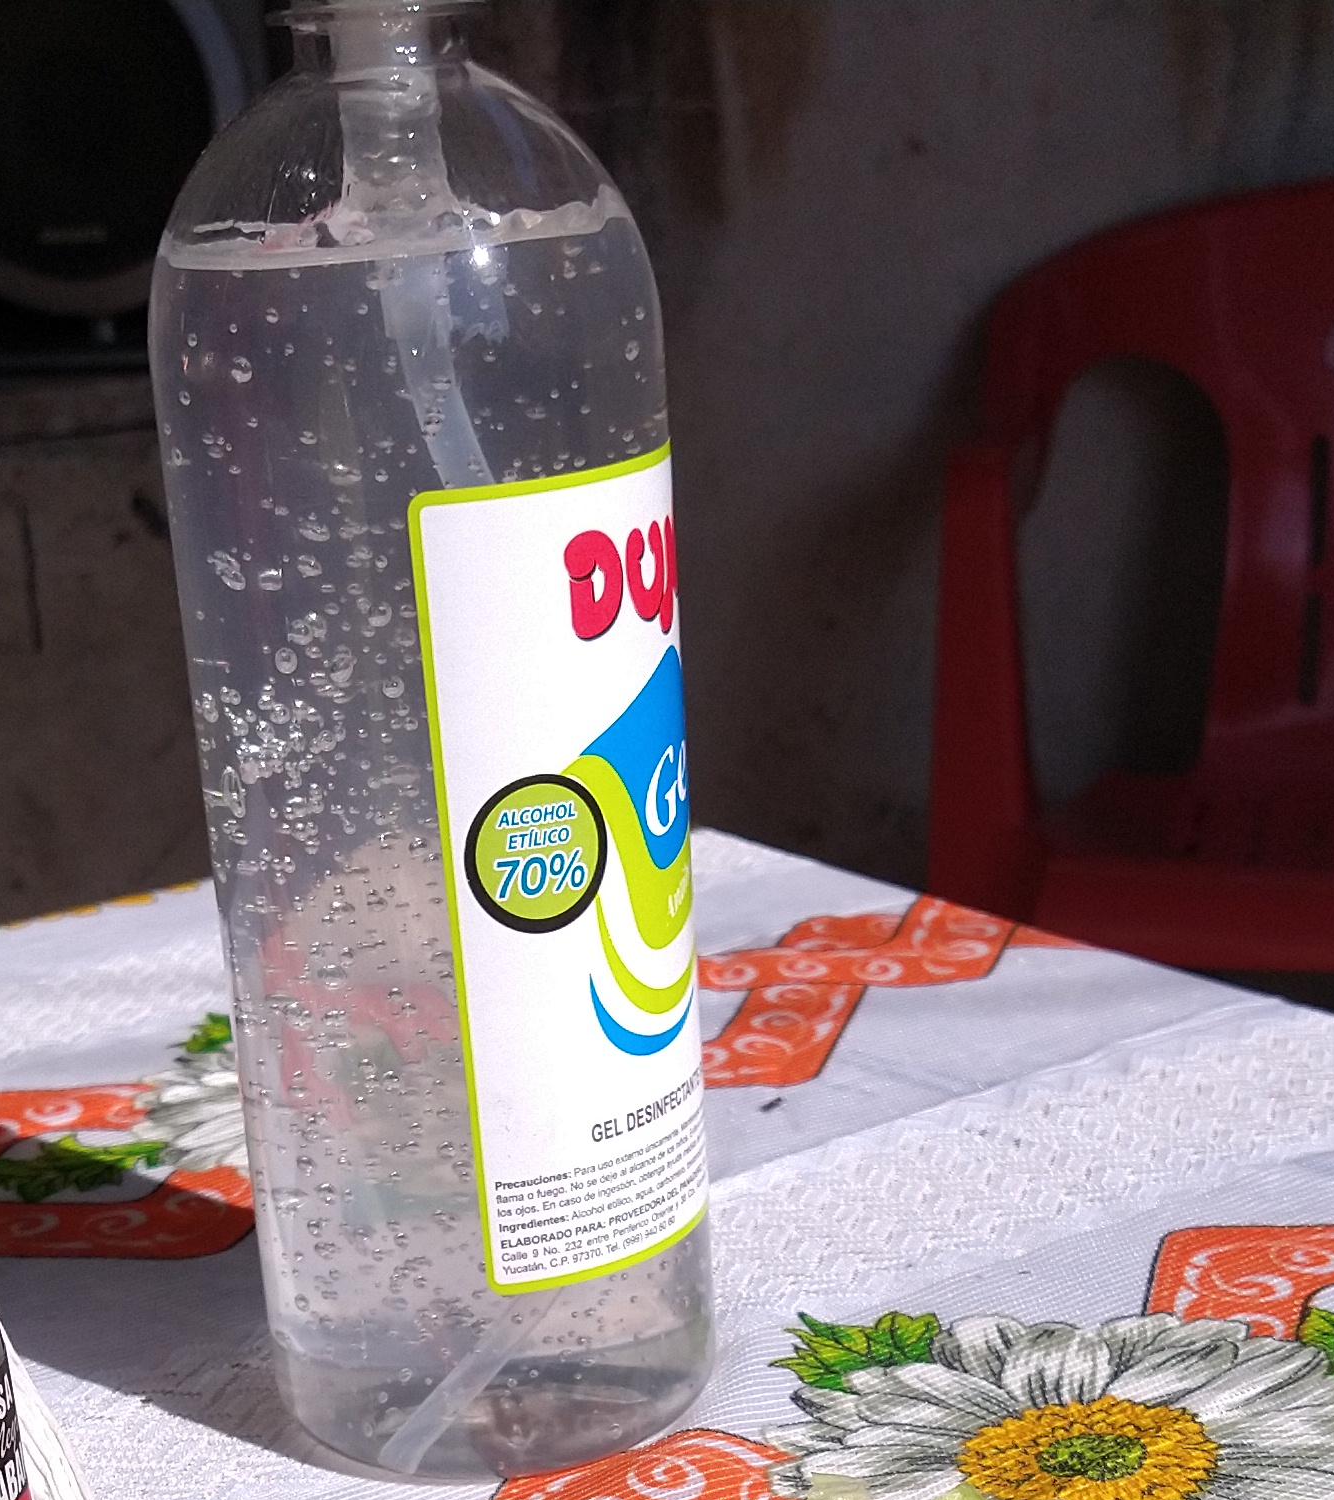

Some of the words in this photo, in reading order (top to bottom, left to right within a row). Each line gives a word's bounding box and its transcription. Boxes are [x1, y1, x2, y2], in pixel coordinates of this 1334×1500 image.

[497, 802, 576, 828] ALCOHOL
[507, 827, 570, 851] ETÍLICO
[496, 849, 586, 900] 70%
[592, 1118, 623, 1142] GEL
[495, 1172, 571, 1191] Precauciones:
[574, 1165, 596, 1177] Para
[598, 1160, 613, 1171] uso
[496, 1192, 524, 1204] flama
[528, 1192, 534, 1200] o
[537, 1186, 568, 1198] fuego.
[571, 1181, 584, 1192] No
[587, 1178, 597, 1187] se
[497, 1208, 512, 1218] los
[515, 1204, 539, 1217] ojos.
[542, 1201, 556, 1211] En
[559, 1195, 581, 1208] caso
[584, 1191, 596, 1202] de
[499, 1215, 569, 1233] Ingredientes:
[571, 1204, 605, 1220] Alcohol
[500, 1229, 572, 1249] ELABORADO
[575, 1222, 606, 1236] PARA:
[609, 1195, 666, 1226] PROVEEDORA
[502, 1252, 527, 1262] Calle
[543, 1246, 560, 1255] No.
[587, 1233, 609, 1246] entre
[503, 1262, 547, 1275] Yucatán,
[550, 1256, 570, 1267] C.P.
[572, 1249, 604, 1263] 97370.
